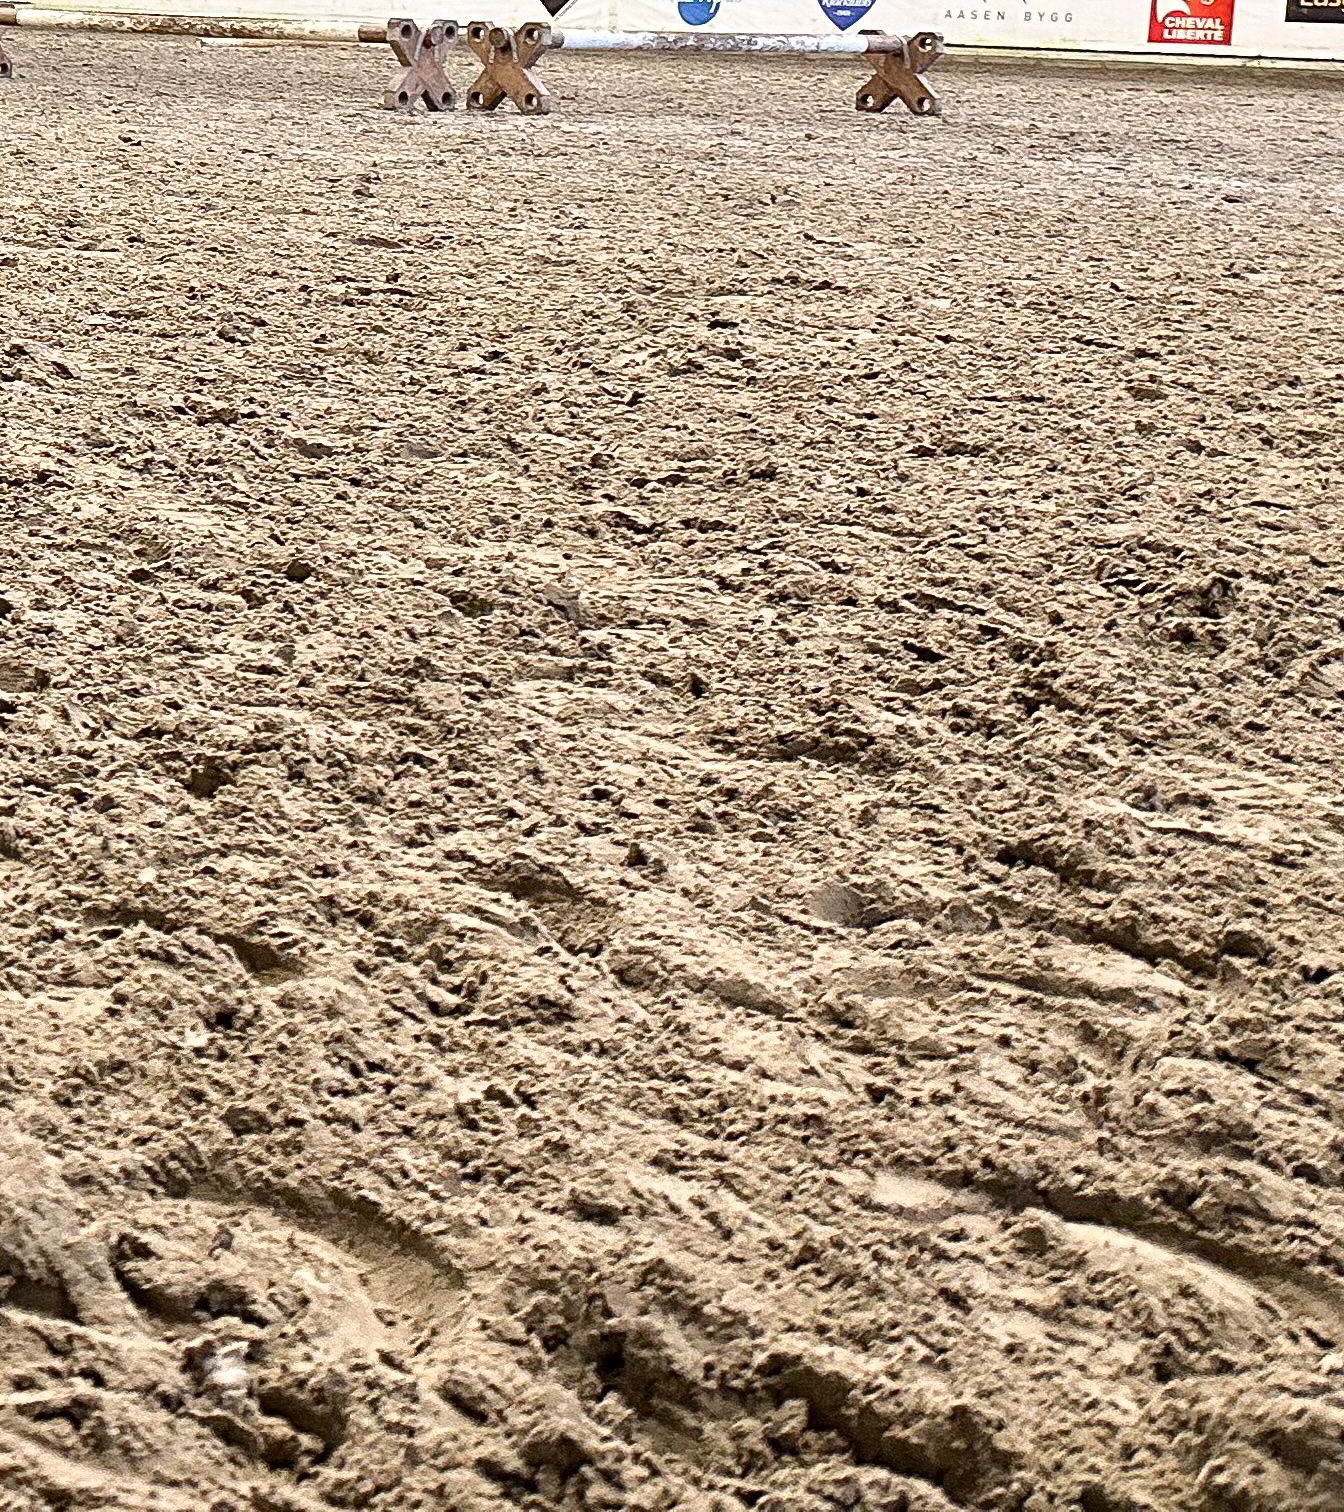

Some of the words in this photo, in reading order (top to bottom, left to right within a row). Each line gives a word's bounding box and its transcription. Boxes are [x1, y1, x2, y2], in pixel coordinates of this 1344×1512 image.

[944, 10, 1006, 21] AASEN
[1023, 11, 1073, 22] BYGG
[1164, 16, 1225, 29] CHEVAL
